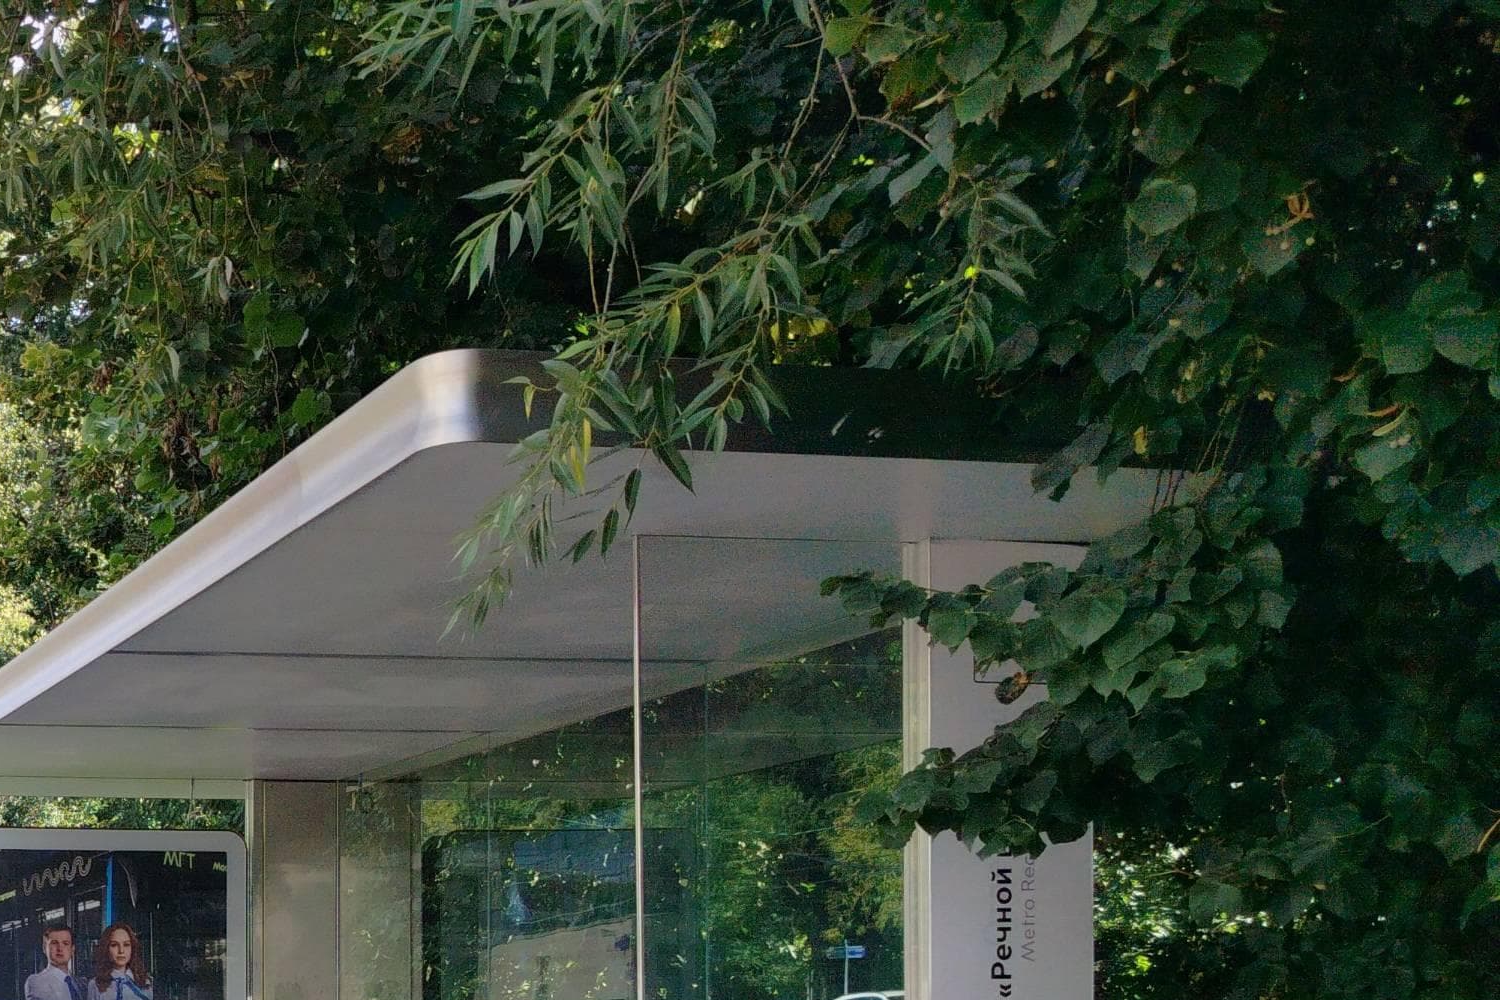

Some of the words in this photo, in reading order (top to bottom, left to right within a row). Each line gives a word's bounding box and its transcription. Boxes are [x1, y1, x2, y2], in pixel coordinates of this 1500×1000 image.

[163, 851, 196, 870] МГТ
[990, 867, 1013, 998] «Речной
[1021, 898, 1036, 962] Metro
